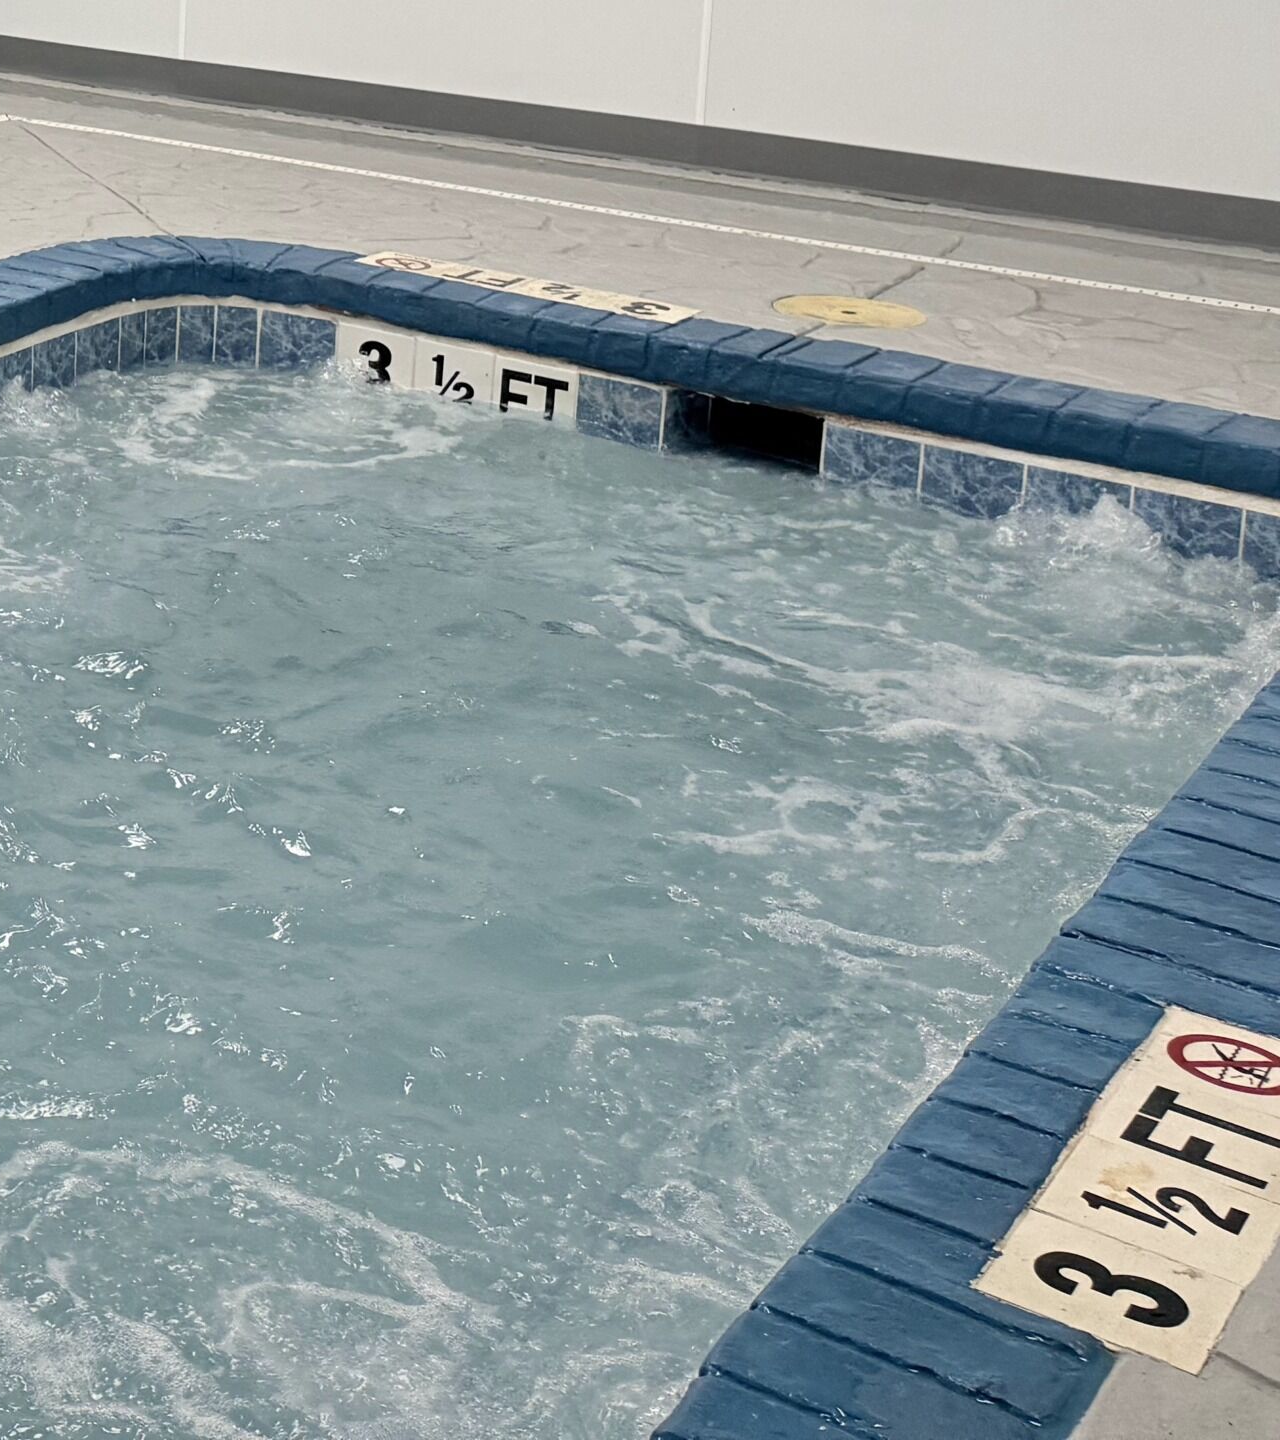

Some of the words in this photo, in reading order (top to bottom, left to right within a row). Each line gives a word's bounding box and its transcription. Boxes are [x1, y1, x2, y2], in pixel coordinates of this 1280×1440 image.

[443, 269, 526, 289] FT
[620, 301, 671, 317] 3
[359, 340, 392, 384] 3
[500, 367, 569, 421] FT
[1033, 1250, 1190, 1328] 3
[1119, 1085, 1280, 1190] FT
